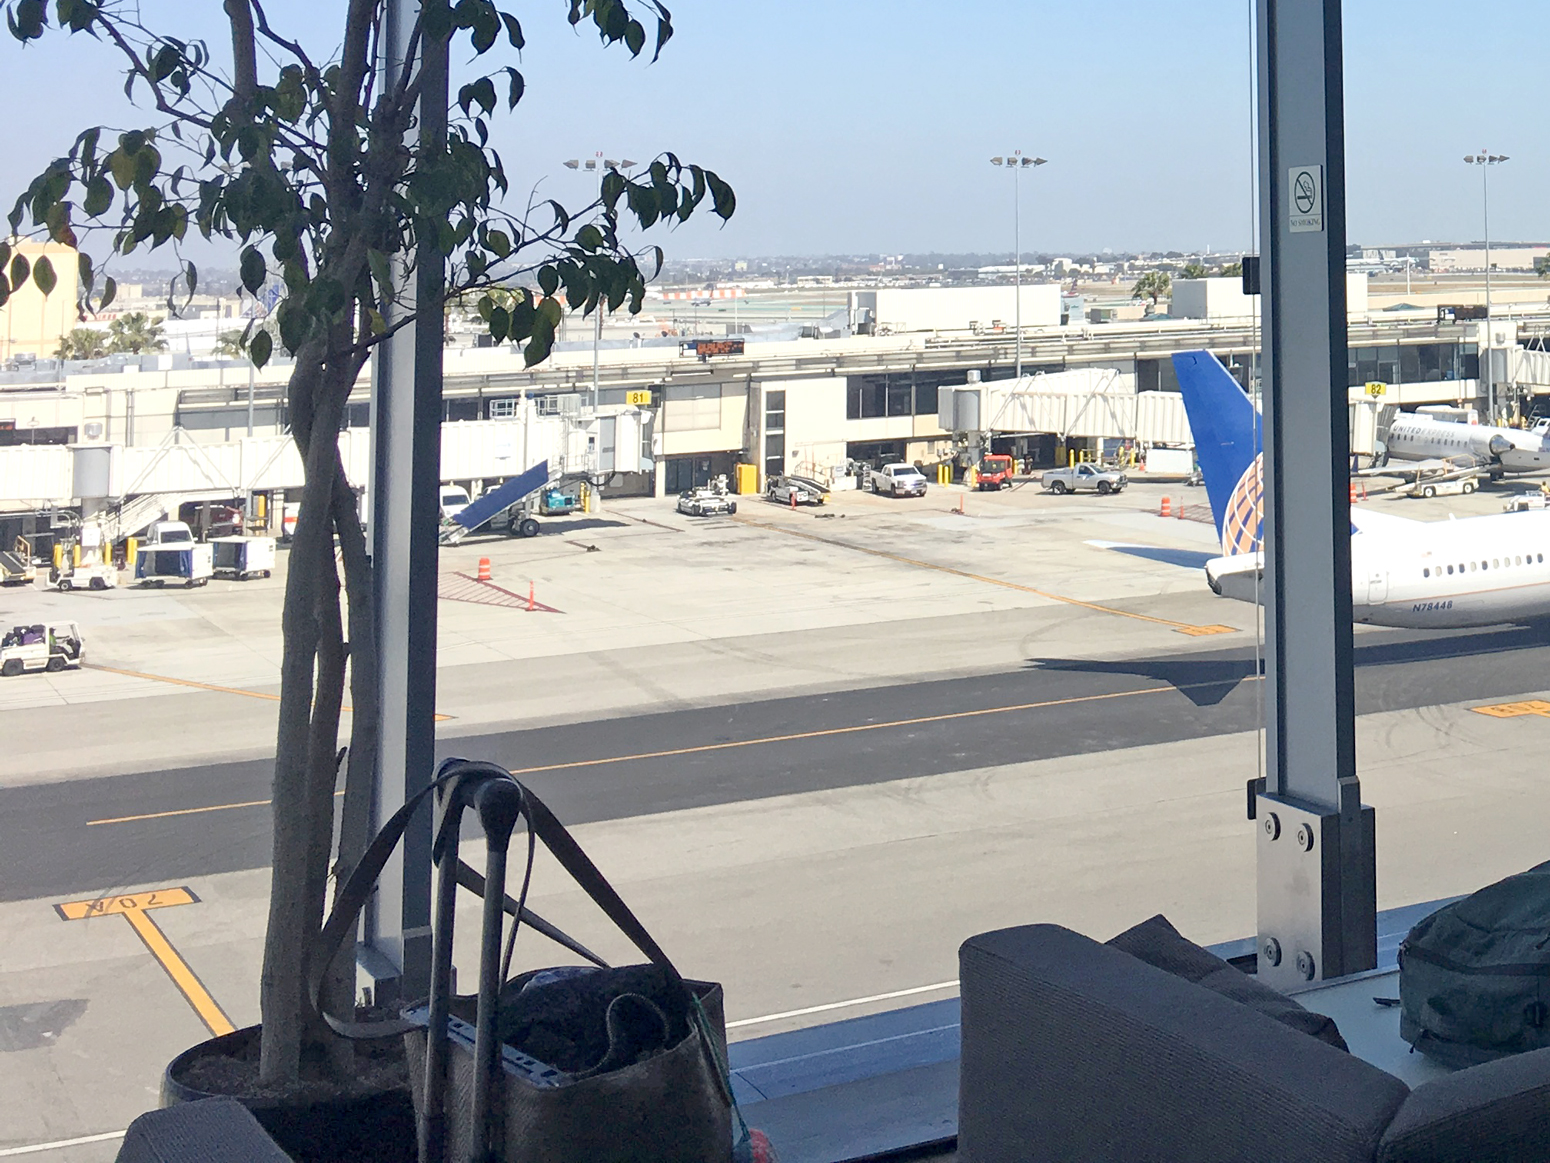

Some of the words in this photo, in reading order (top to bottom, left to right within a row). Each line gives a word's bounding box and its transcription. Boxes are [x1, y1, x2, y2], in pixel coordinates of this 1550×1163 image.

[1370, 383, 1382, 395] 82
[632, 392, 644, 404] 81
[1412, 600, 1453, 613] N78448
